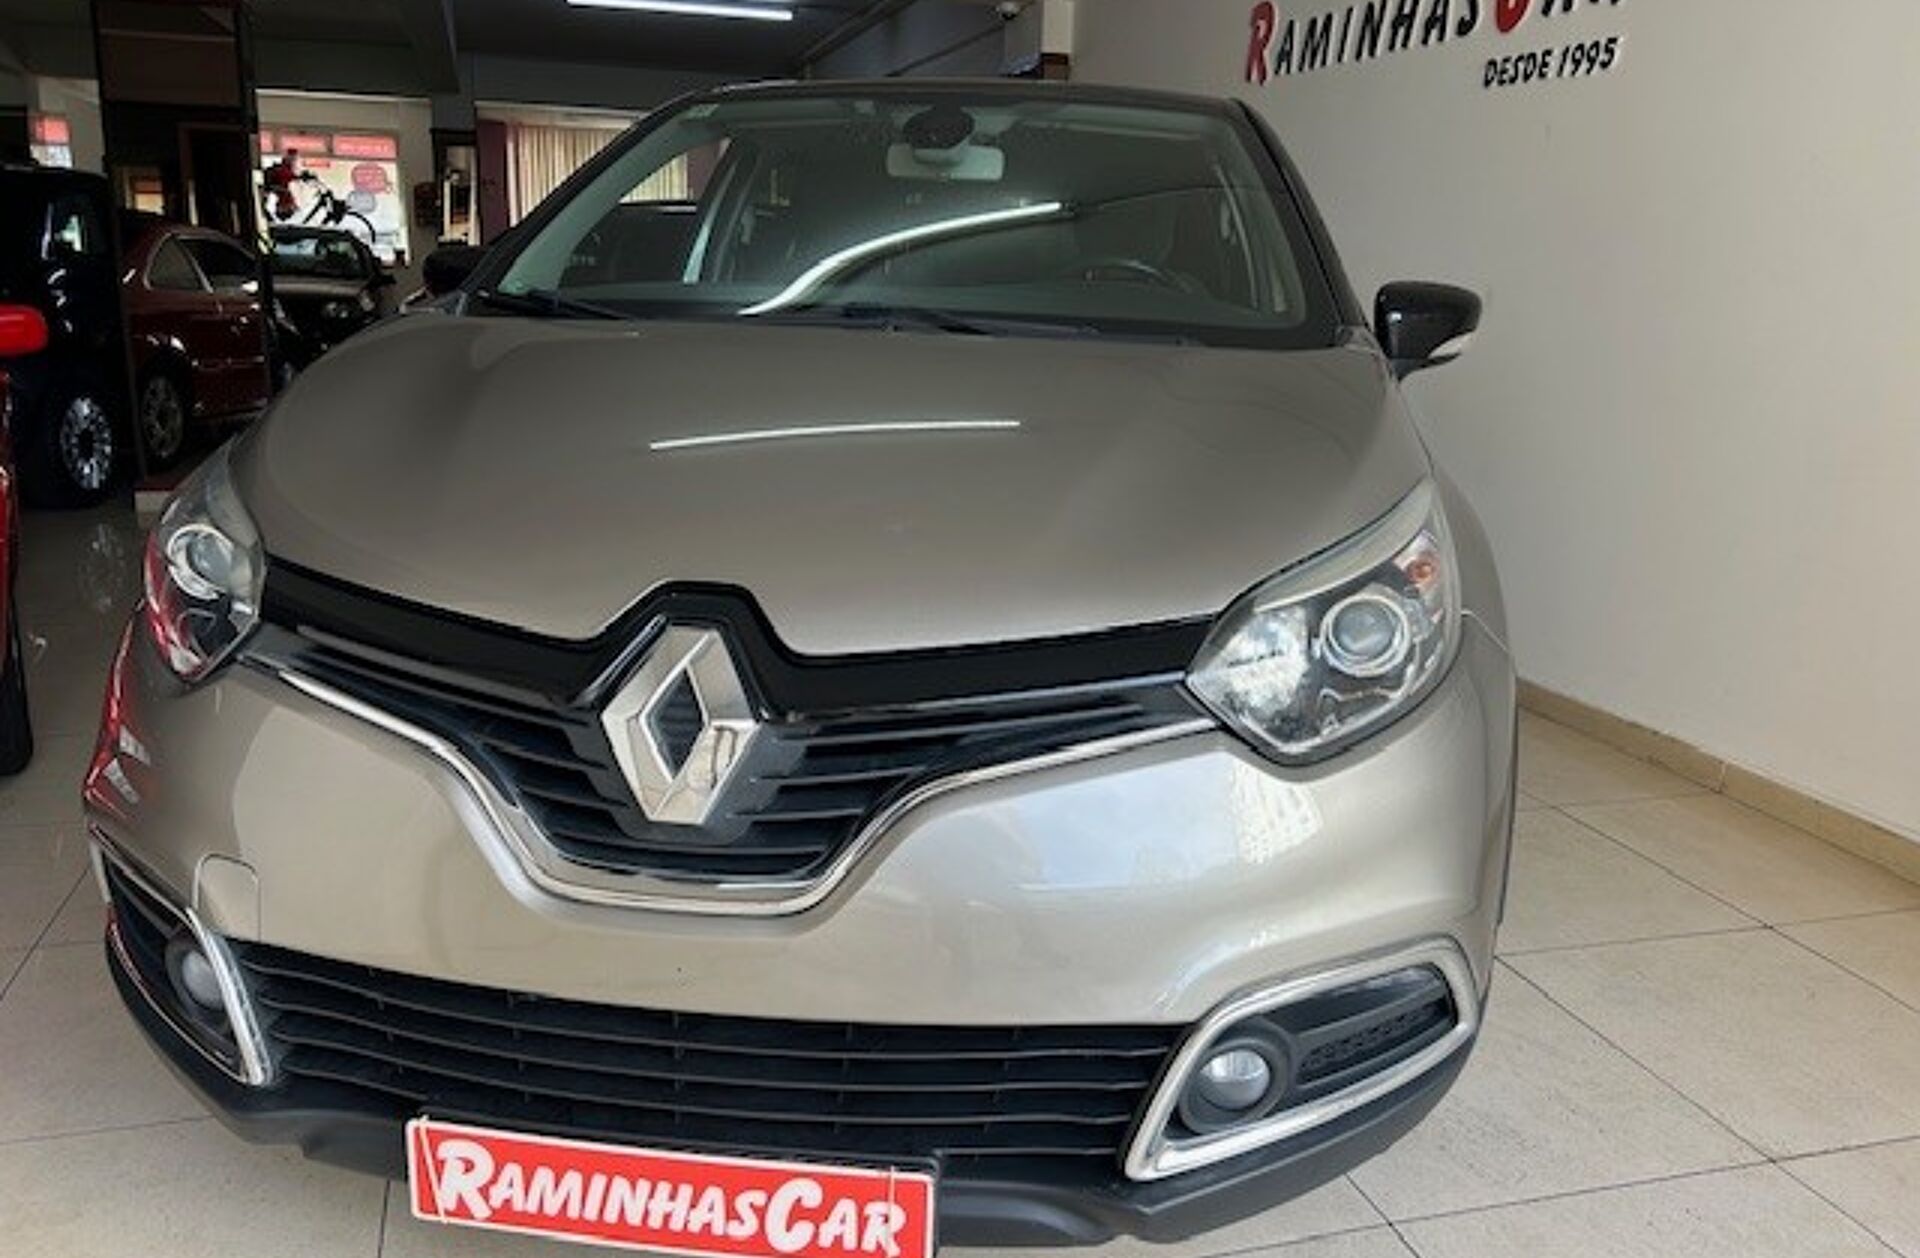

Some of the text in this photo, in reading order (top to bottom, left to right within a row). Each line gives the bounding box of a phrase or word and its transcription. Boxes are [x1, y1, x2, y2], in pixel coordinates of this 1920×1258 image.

[1246, 0, 1620, 85] RAMINHAS
[1484, 37, 1618, 88] DESDE 1995
[437, 1138, 906, 1258] RAMINHASCAR
